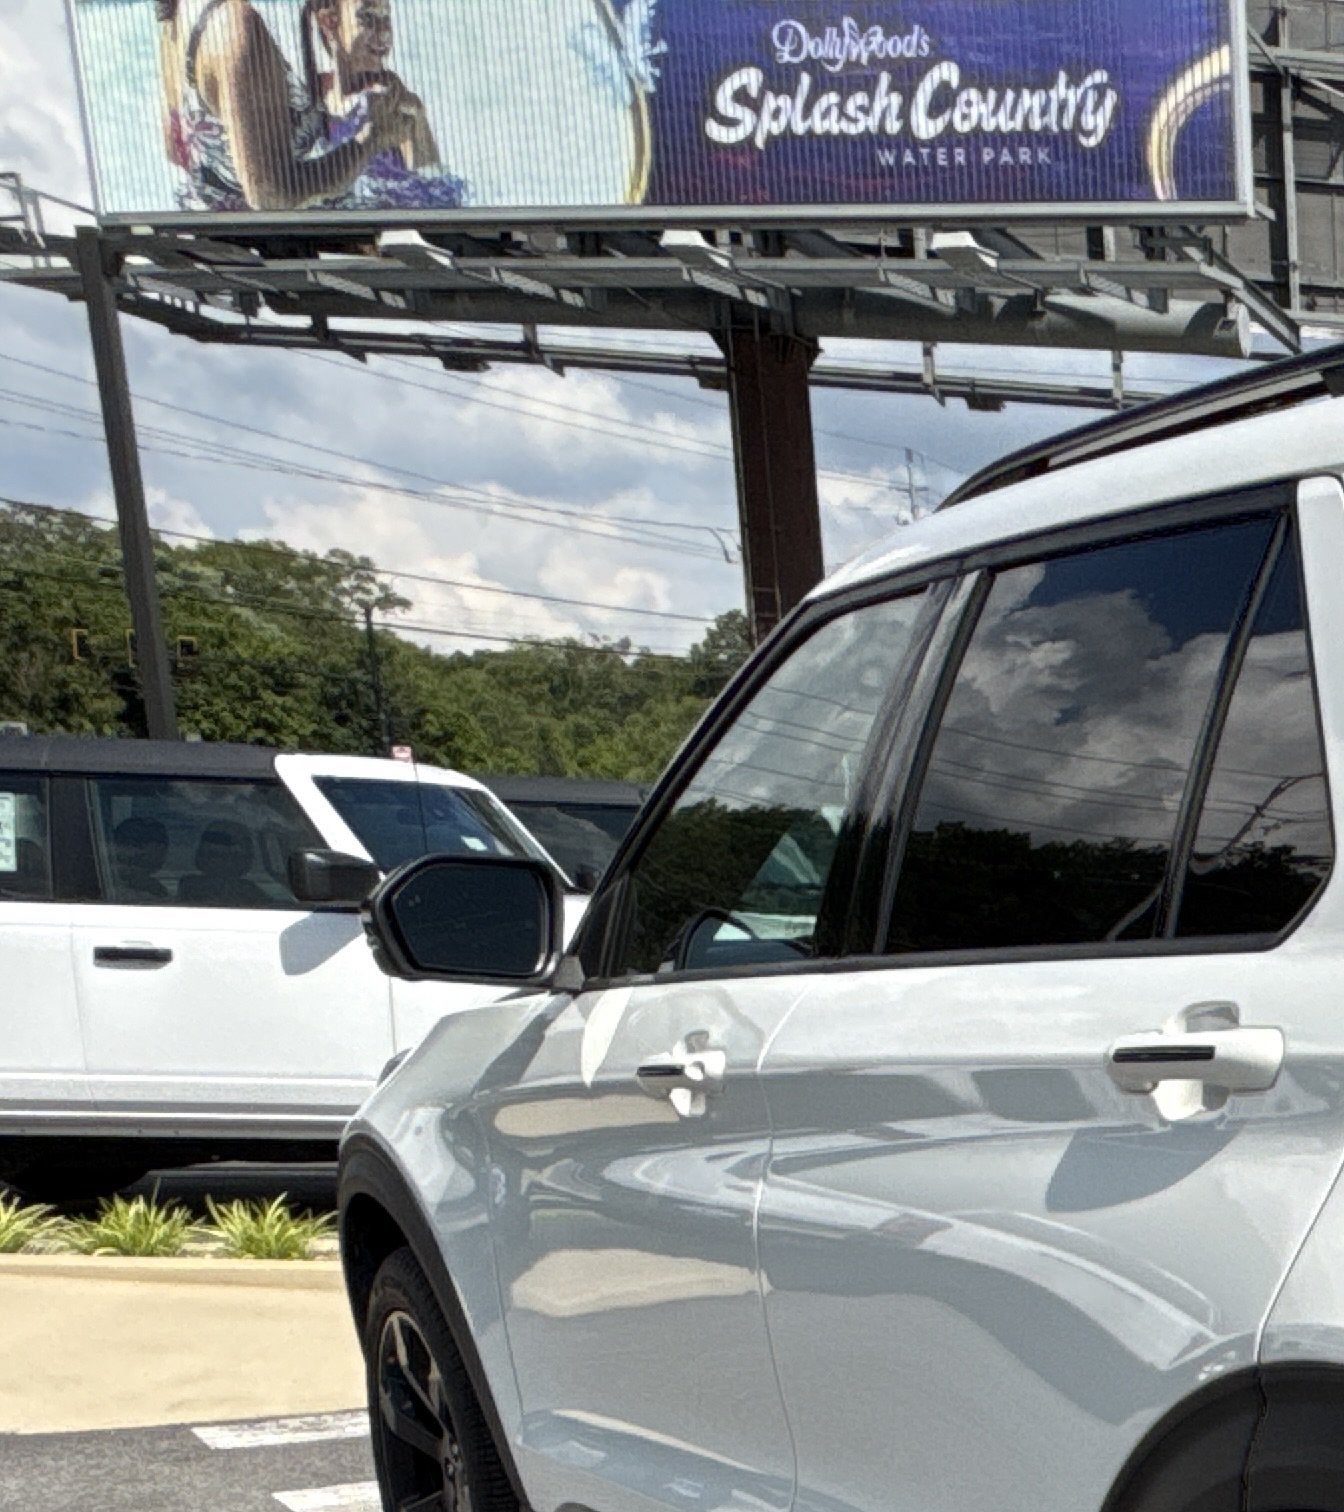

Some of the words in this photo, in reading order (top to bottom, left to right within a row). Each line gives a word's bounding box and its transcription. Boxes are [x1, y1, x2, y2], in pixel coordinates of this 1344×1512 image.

[705, 66, 903, 150] Splash
[910, 61, 1118, 148] Country
[877, 147, 966, 167] WATER
[982, 147, 1052, 166] PARK
